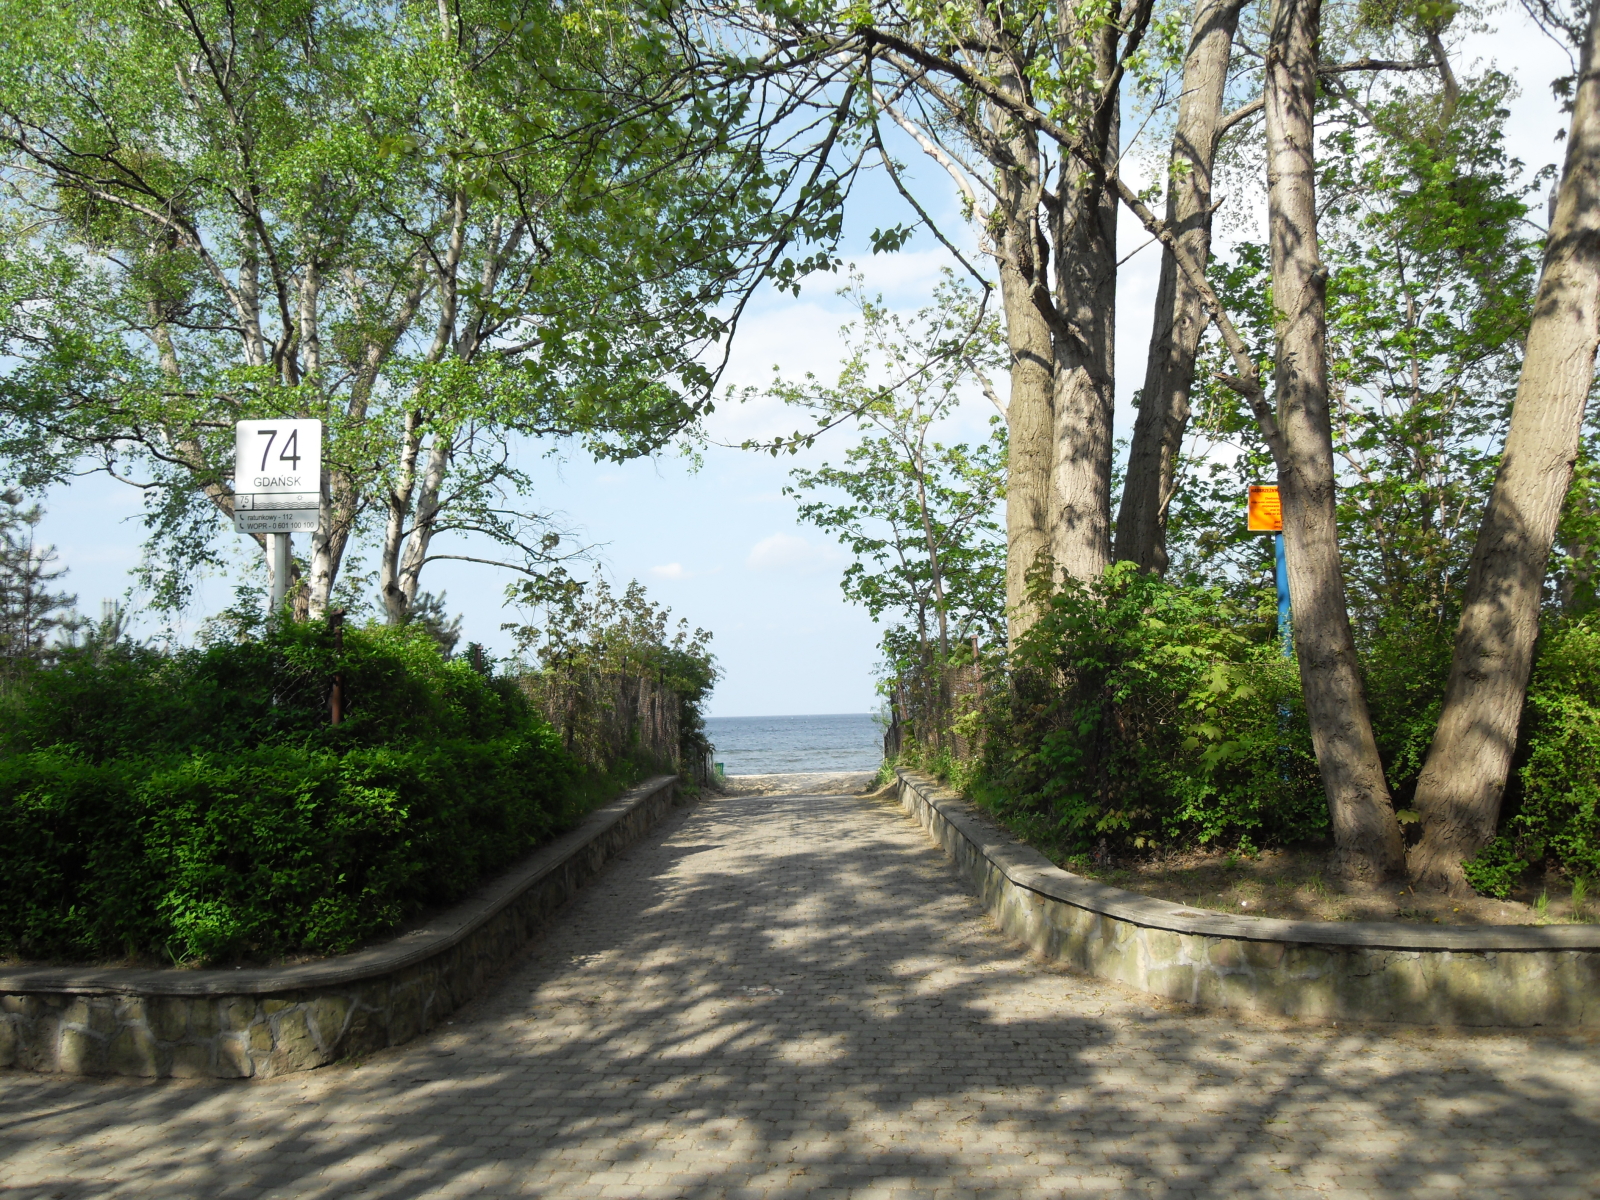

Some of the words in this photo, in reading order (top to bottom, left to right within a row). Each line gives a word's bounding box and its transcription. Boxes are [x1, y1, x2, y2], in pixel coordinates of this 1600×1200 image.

[257, 429, 301, 471] 74
[253, 474, 301, 487] GDAŃSK
[240, 496, 249, 504] 75
